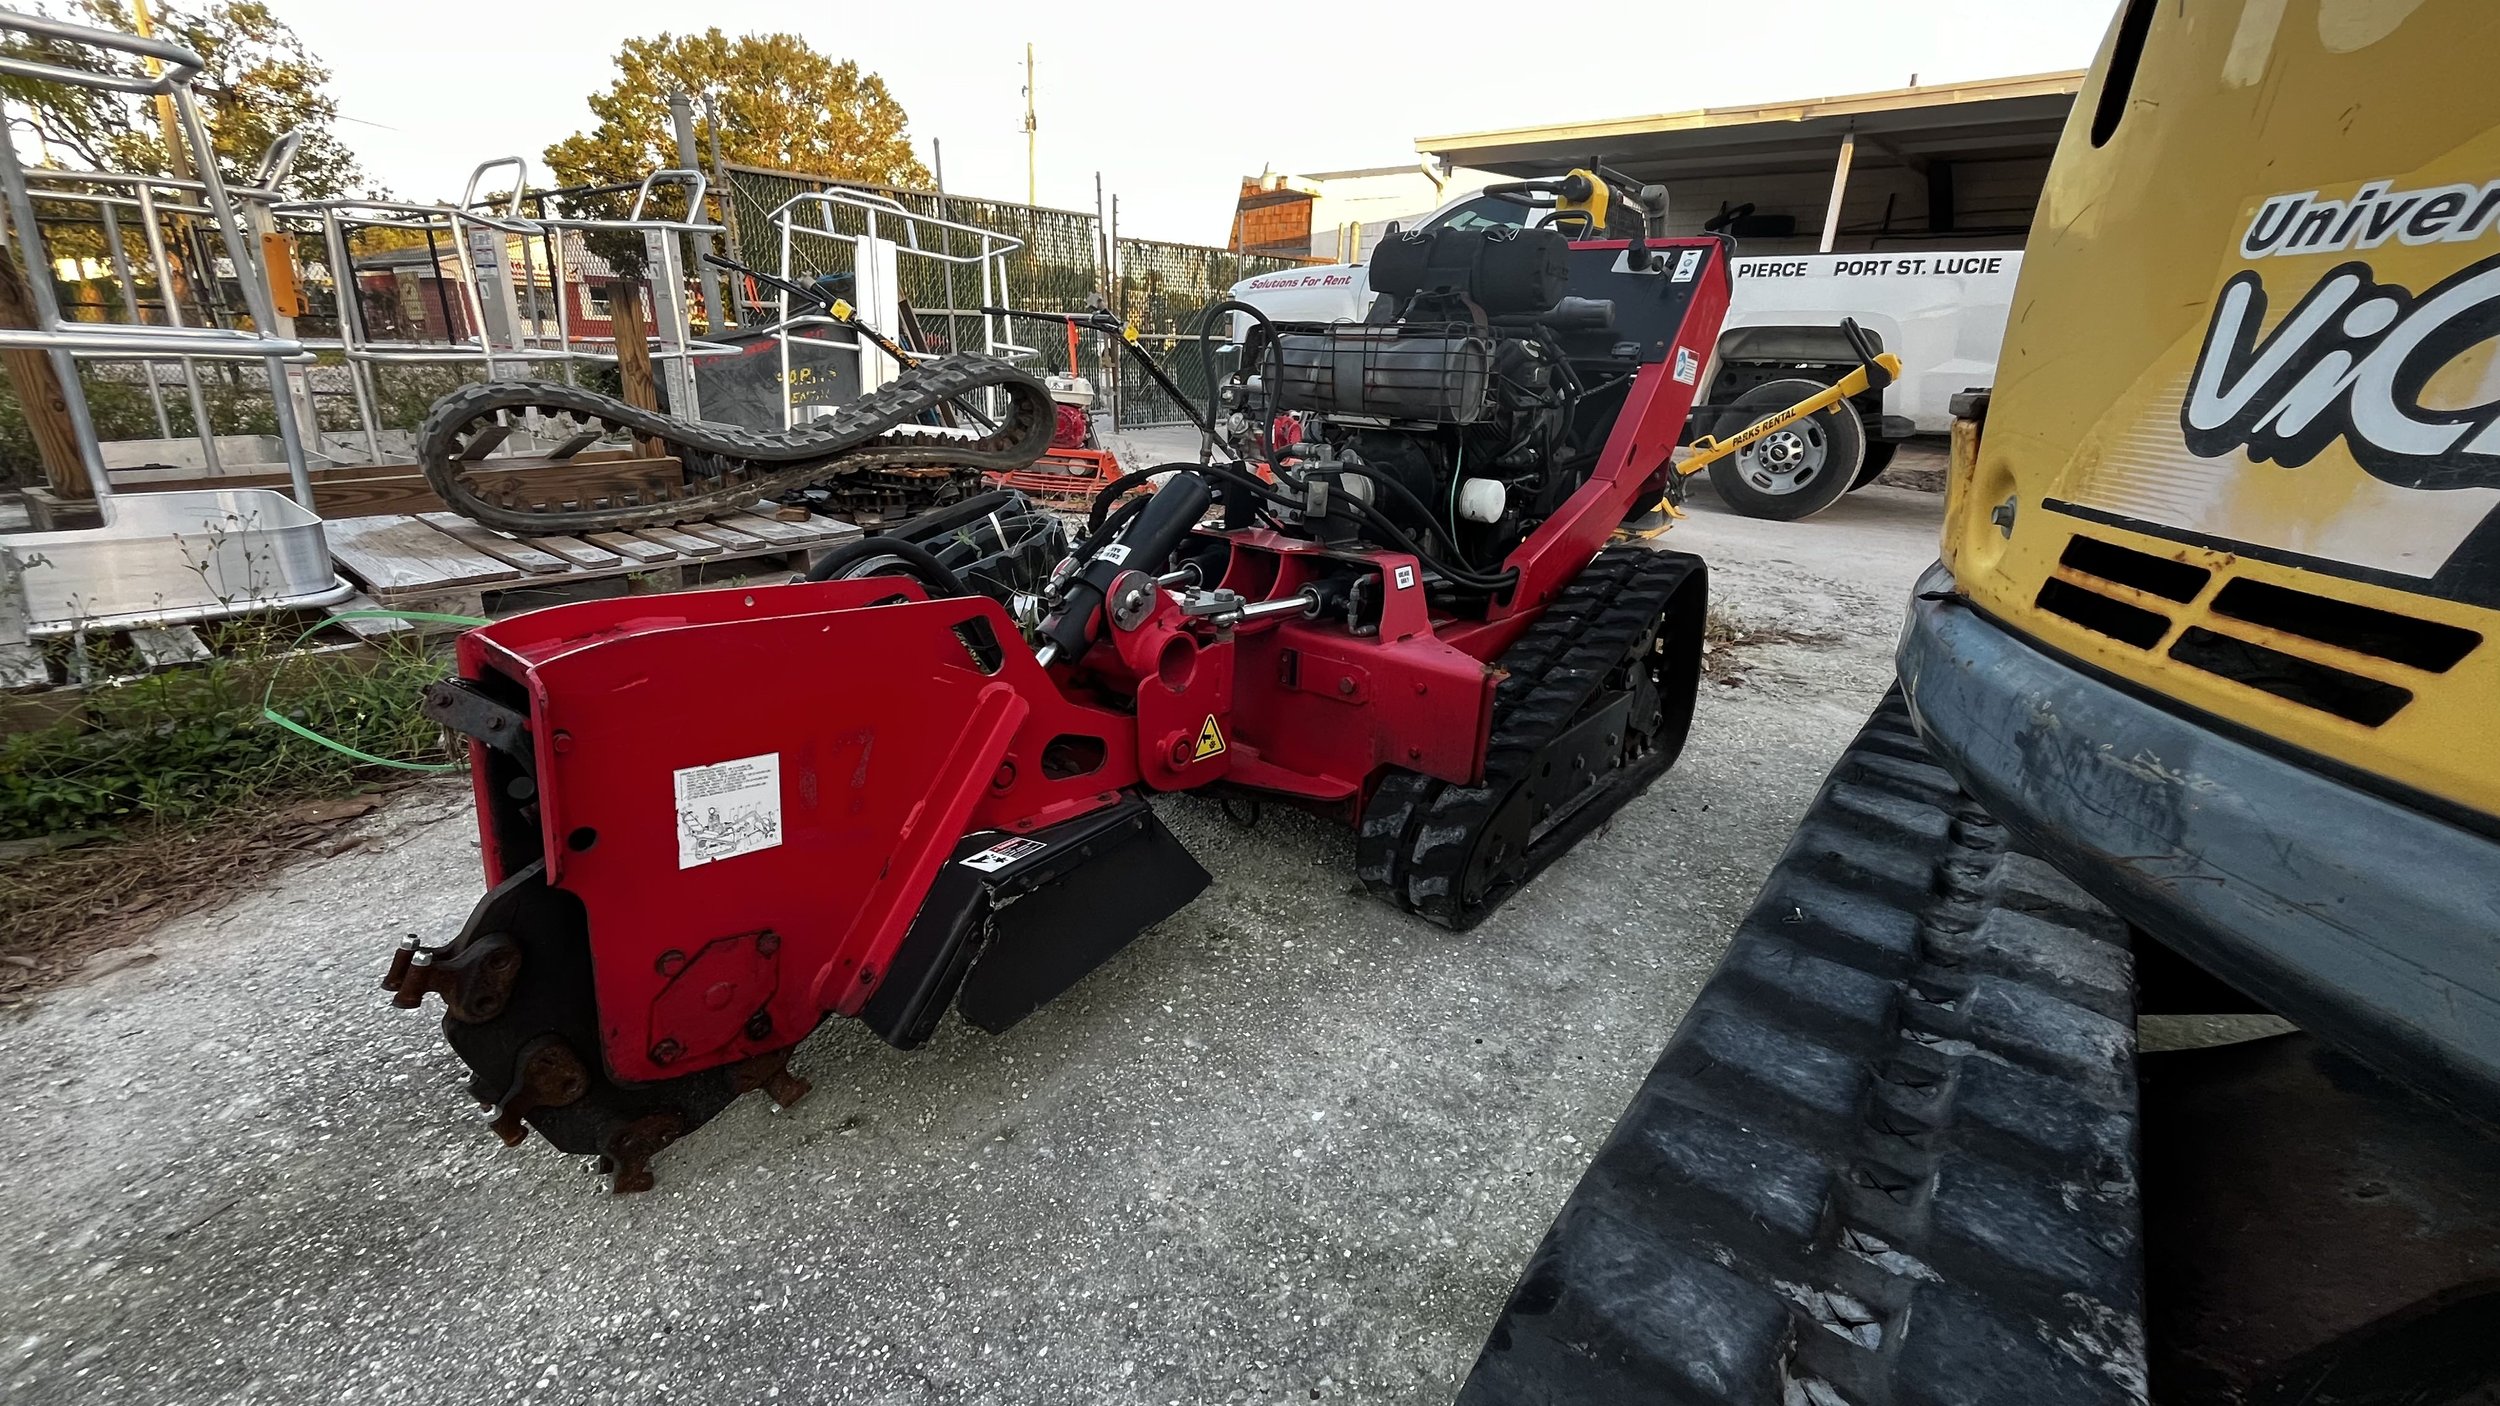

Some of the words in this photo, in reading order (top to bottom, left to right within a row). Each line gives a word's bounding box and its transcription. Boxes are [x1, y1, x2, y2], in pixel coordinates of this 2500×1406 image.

[1738, 262, 1808, 278] PIERCE
[1833, 260, 1892, 277] PORT
[1896, 259, 1927, 276] ST.
[1932, 257, 2002, 275] LUCIE
[1249, 279, 1299, 290] Solutions
[1300, 276, 1322, 287] For
[1322, 275, 1353, 286] Rent
[1732, 426, 1760, 447] PARKS
[1762, 408, 1797, 432] RENTAL
